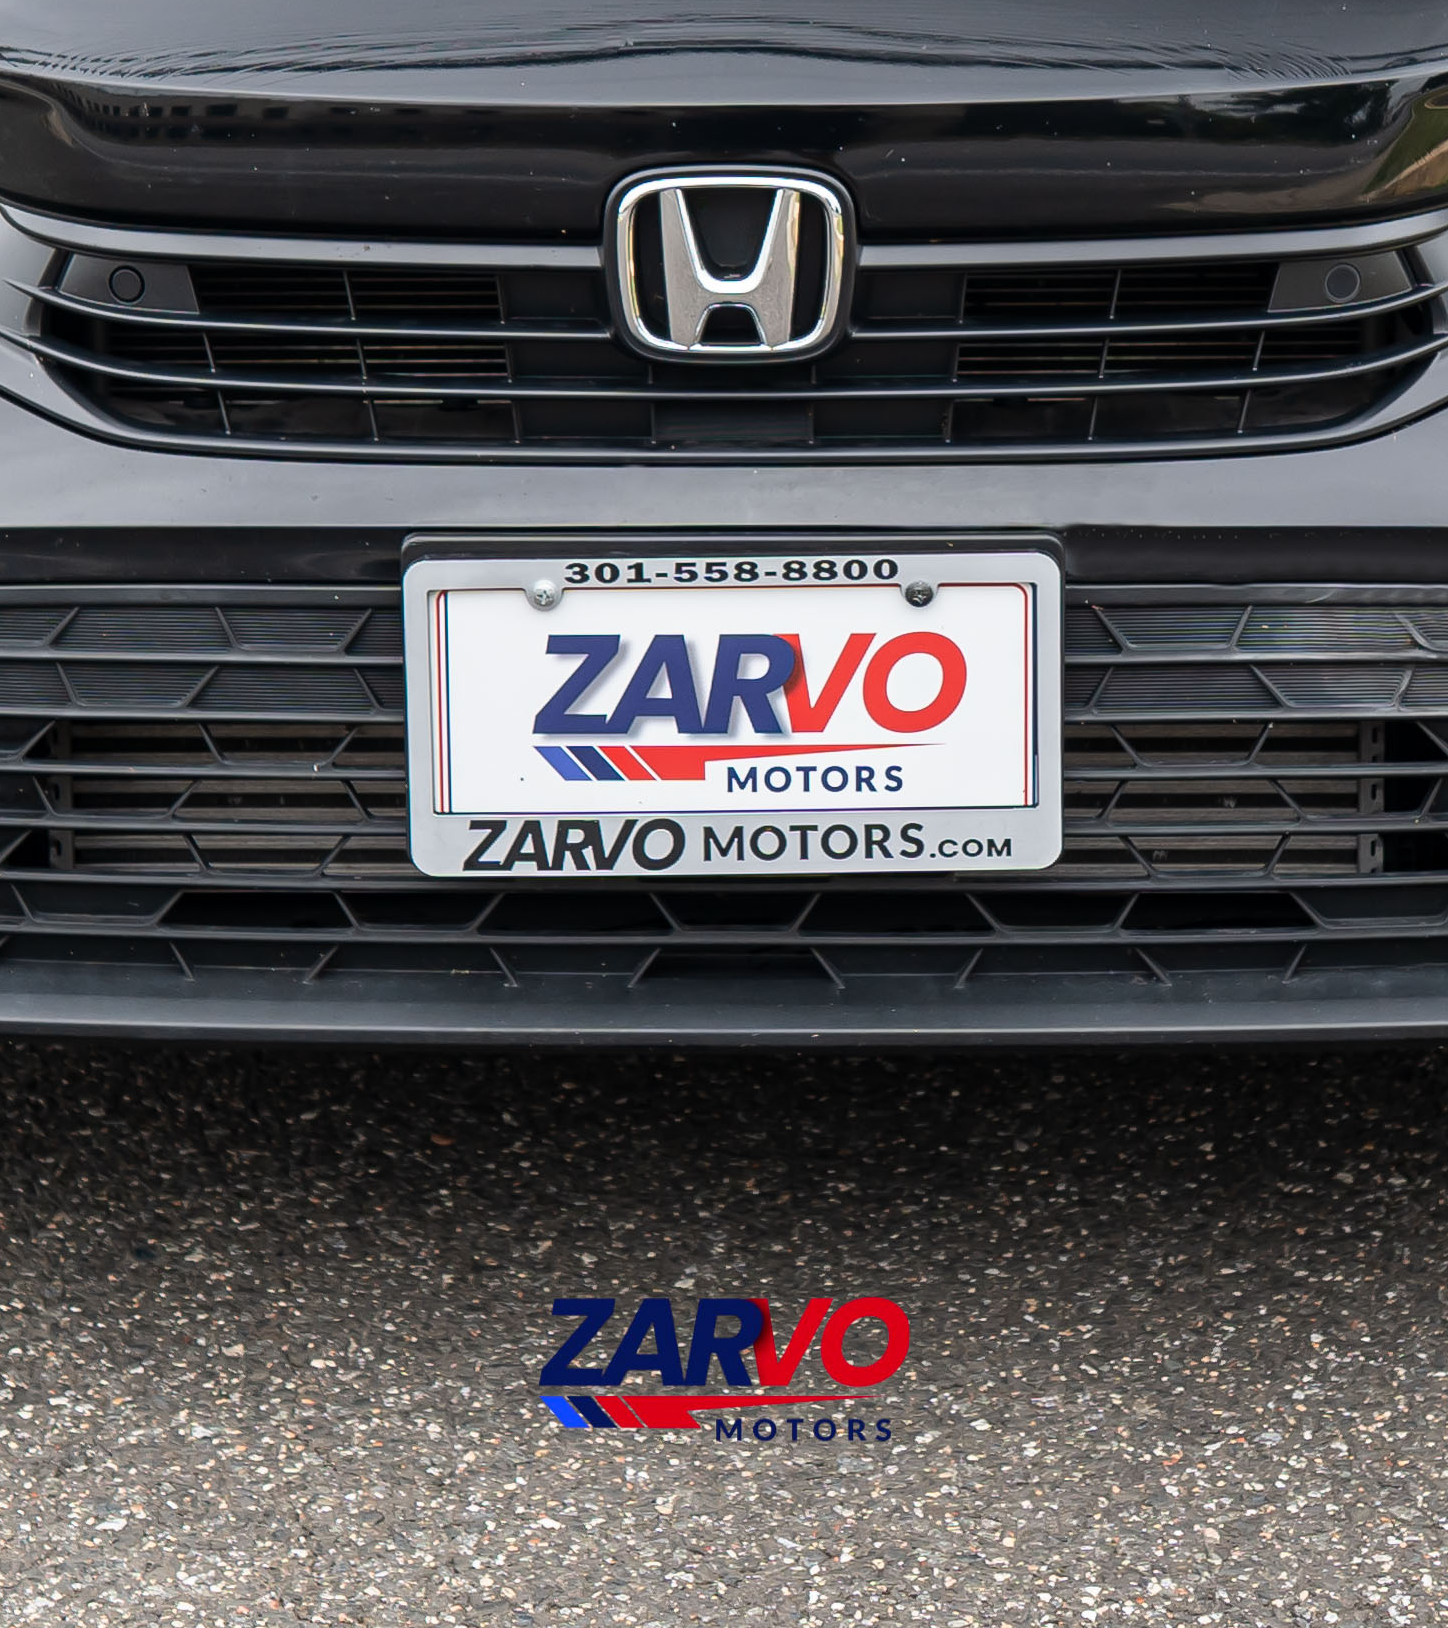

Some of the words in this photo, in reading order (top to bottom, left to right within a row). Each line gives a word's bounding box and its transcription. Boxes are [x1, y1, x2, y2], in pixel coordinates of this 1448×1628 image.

[563, 559, 899, 585] 301-558-8800
[533, 631, 967, 734] ZARVO
[726, 765, 904, 794] MOTORS
[463, 819, 686, 872] ZARVO
